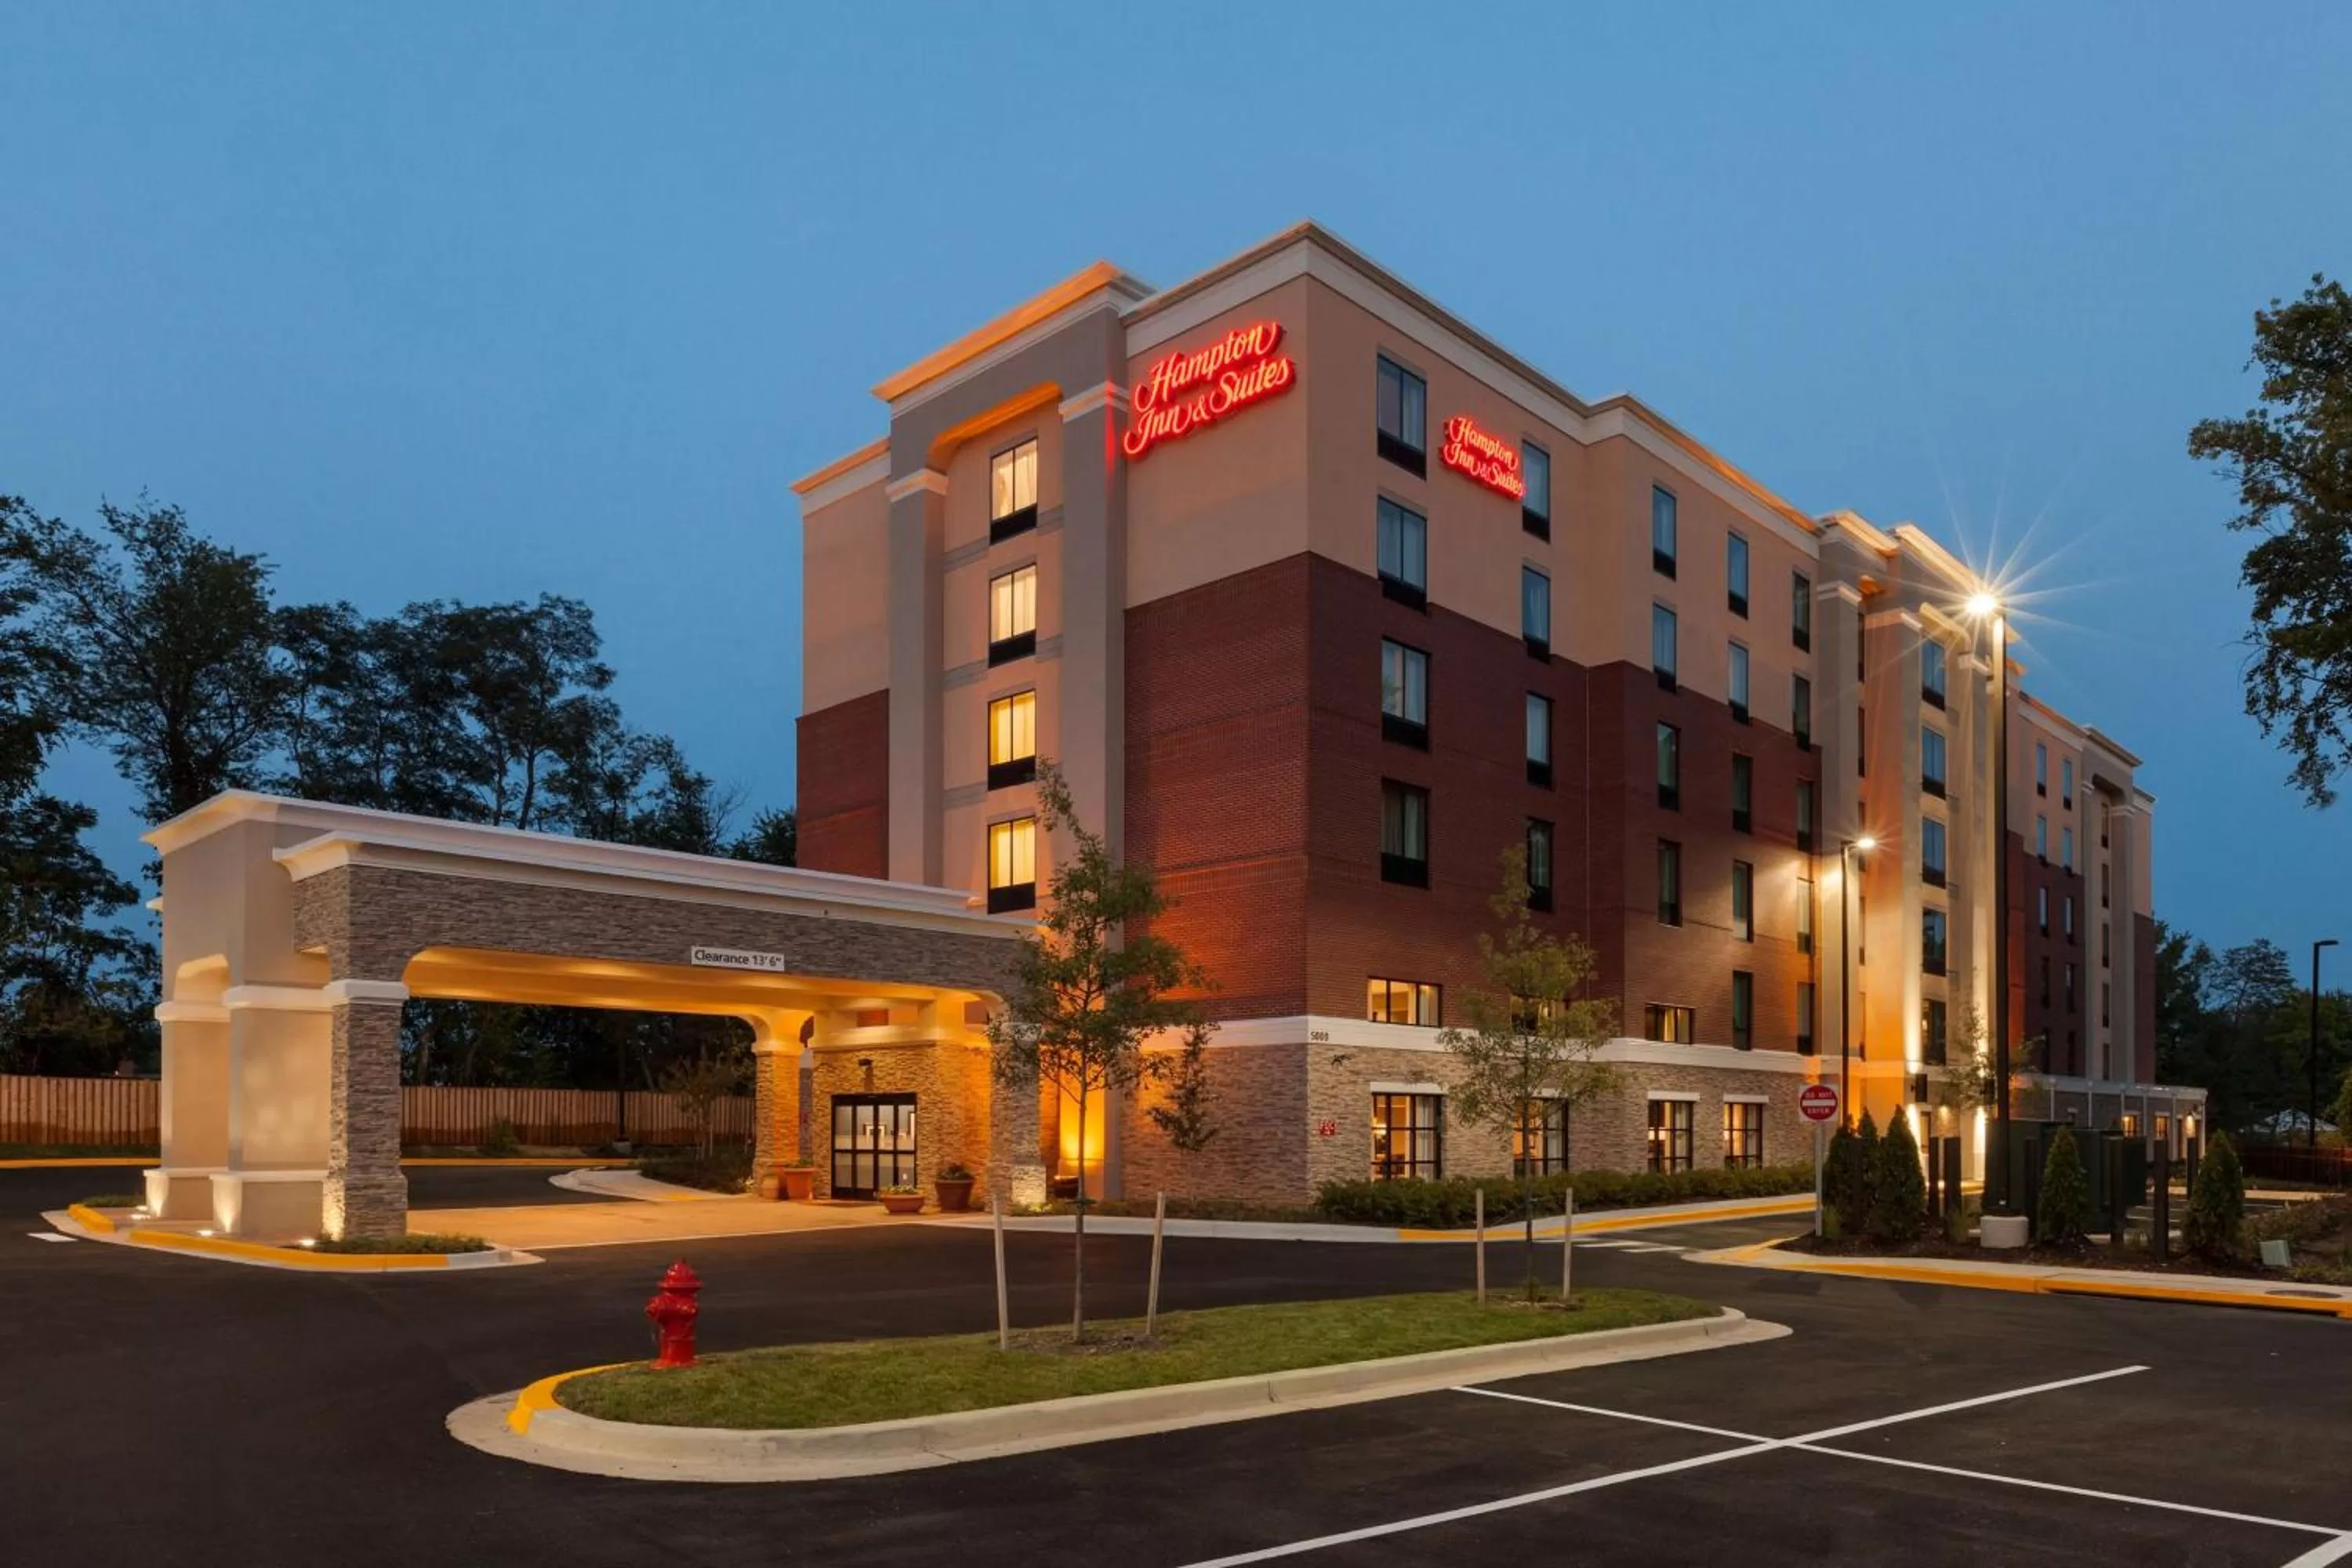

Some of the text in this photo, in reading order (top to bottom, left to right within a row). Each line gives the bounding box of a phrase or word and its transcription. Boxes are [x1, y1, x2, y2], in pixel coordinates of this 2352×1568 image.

[1135, 321, 1277, 412] Hampton
[1123, 357, 1290, 455] Inn & Suites
[1443, 443, 1481, 476] Inn
[1488, 462, 1523, 496] Suites
[1450, 417, 1518, 471] Hampton
[695, 949, 750, 965] Clearance
